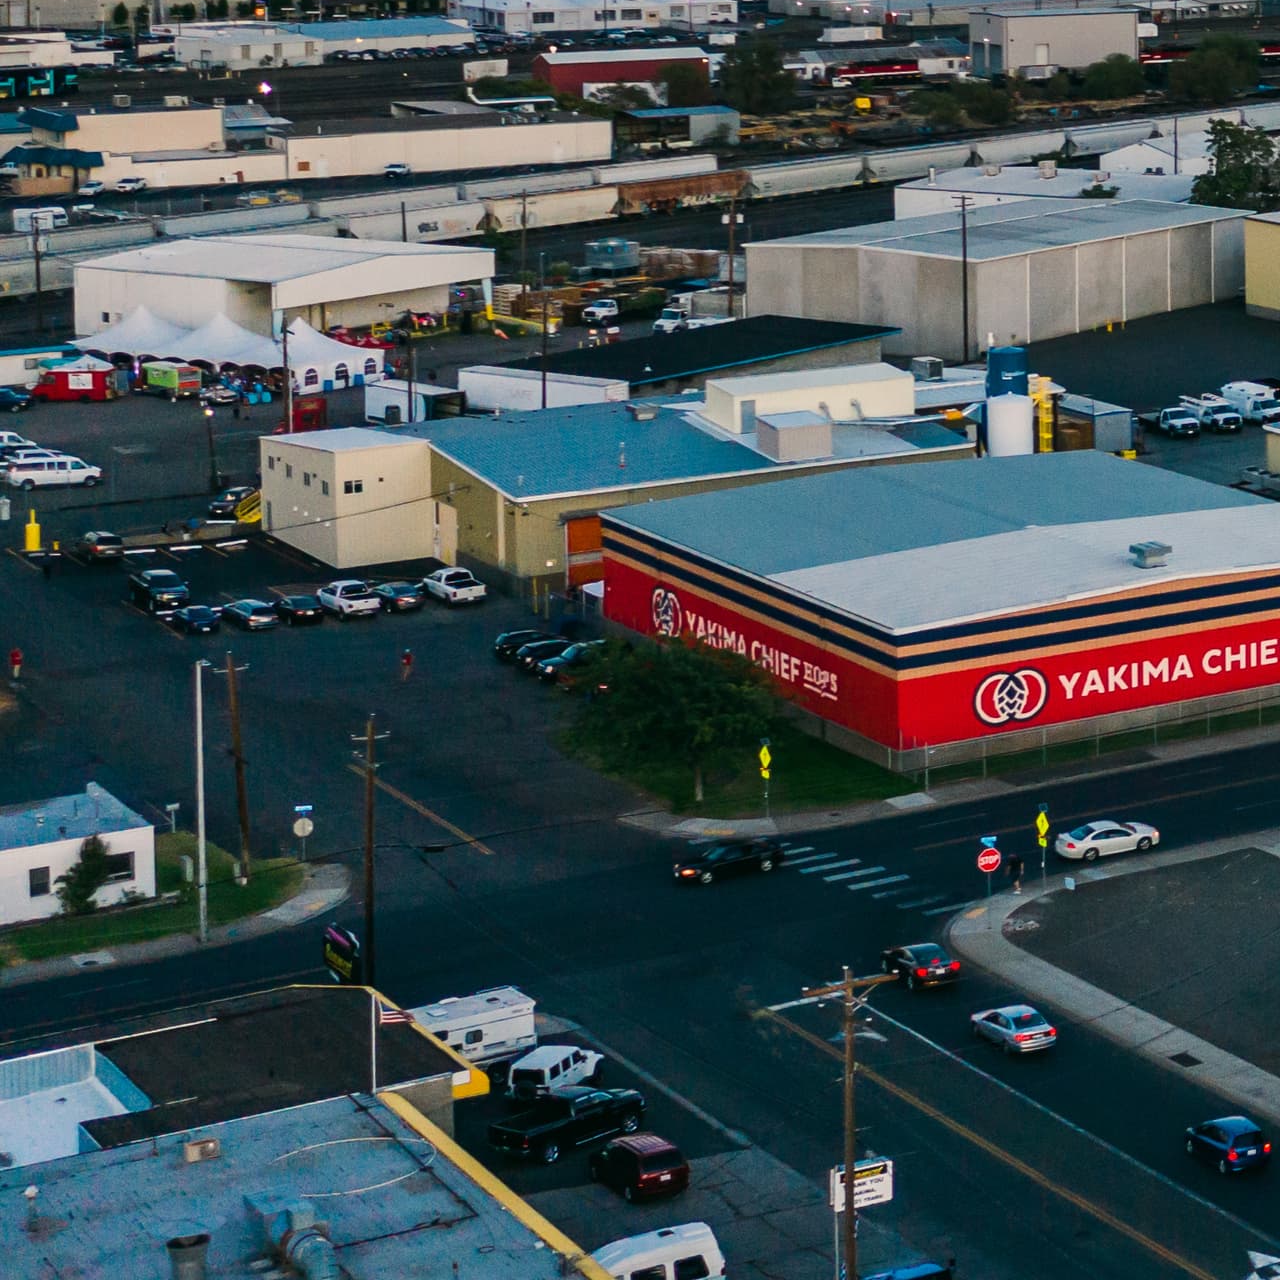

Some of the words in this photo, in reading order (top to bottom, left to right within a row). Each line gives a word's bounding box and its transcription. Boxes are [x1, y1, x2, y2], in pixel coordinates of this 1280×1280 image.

[685, 610, 747, 657] YAKIMA
[751, 640, 800, 683] CHIEF
[803, 661, 838, 694] HOPS
[1059, 654, 1194, 700] YAKIMA
[979, 854, 998, 865] STOP
